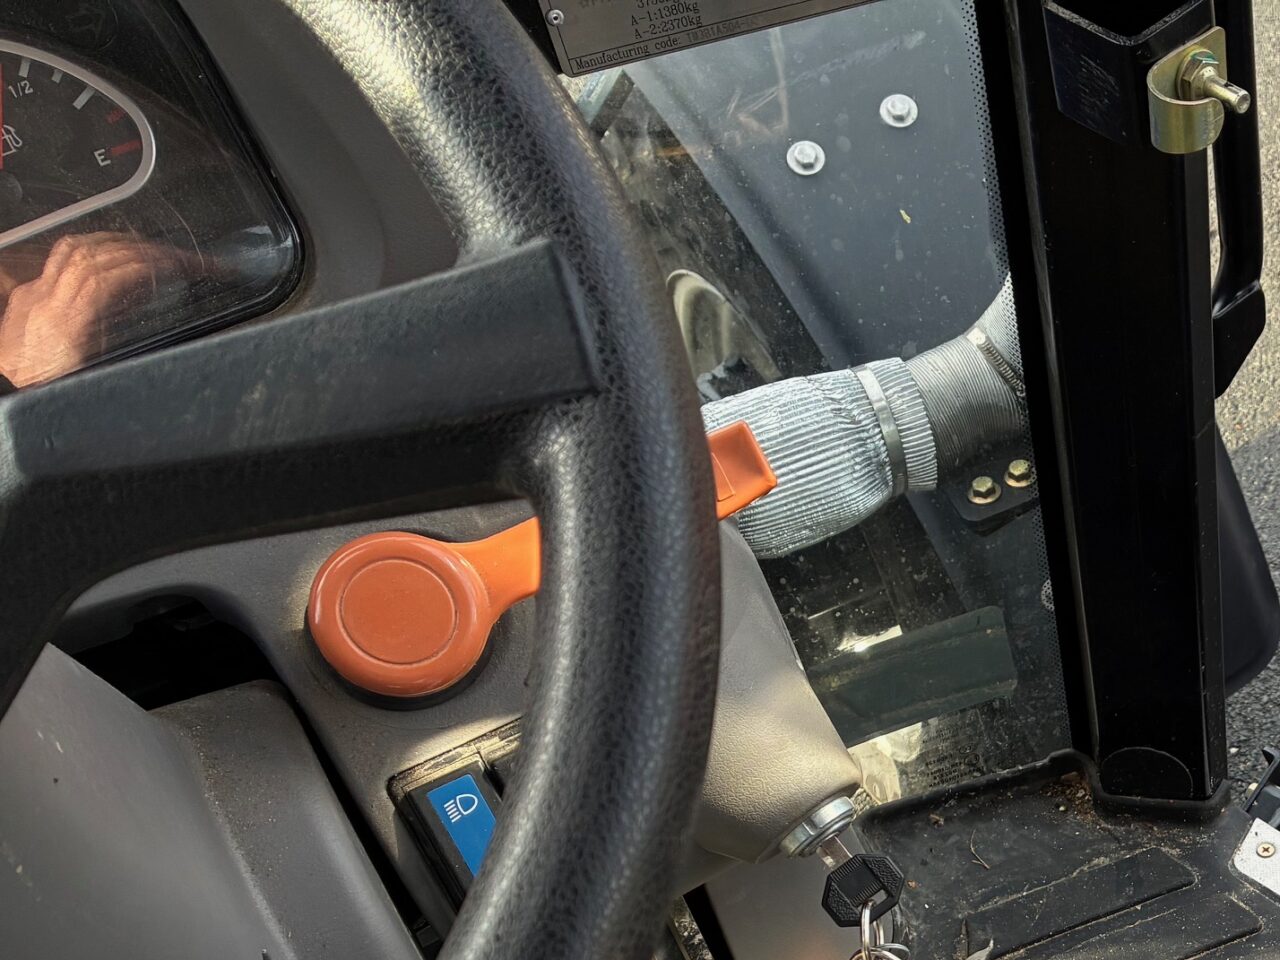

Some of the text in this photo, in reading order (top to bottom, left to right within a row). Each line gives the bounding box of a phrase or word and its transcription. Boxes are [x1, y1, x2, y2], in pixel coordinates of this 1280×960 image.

[631, 2, 699, 26] A-1:1380kg
[634, 15, 703, 40] A-2:2370kg
[575, 44, 650, 70] Manufacturing
[654, 36, 681, 50] code:
[8, 80, 34, 98] 1/2
[93, 148, 111, 166] E
